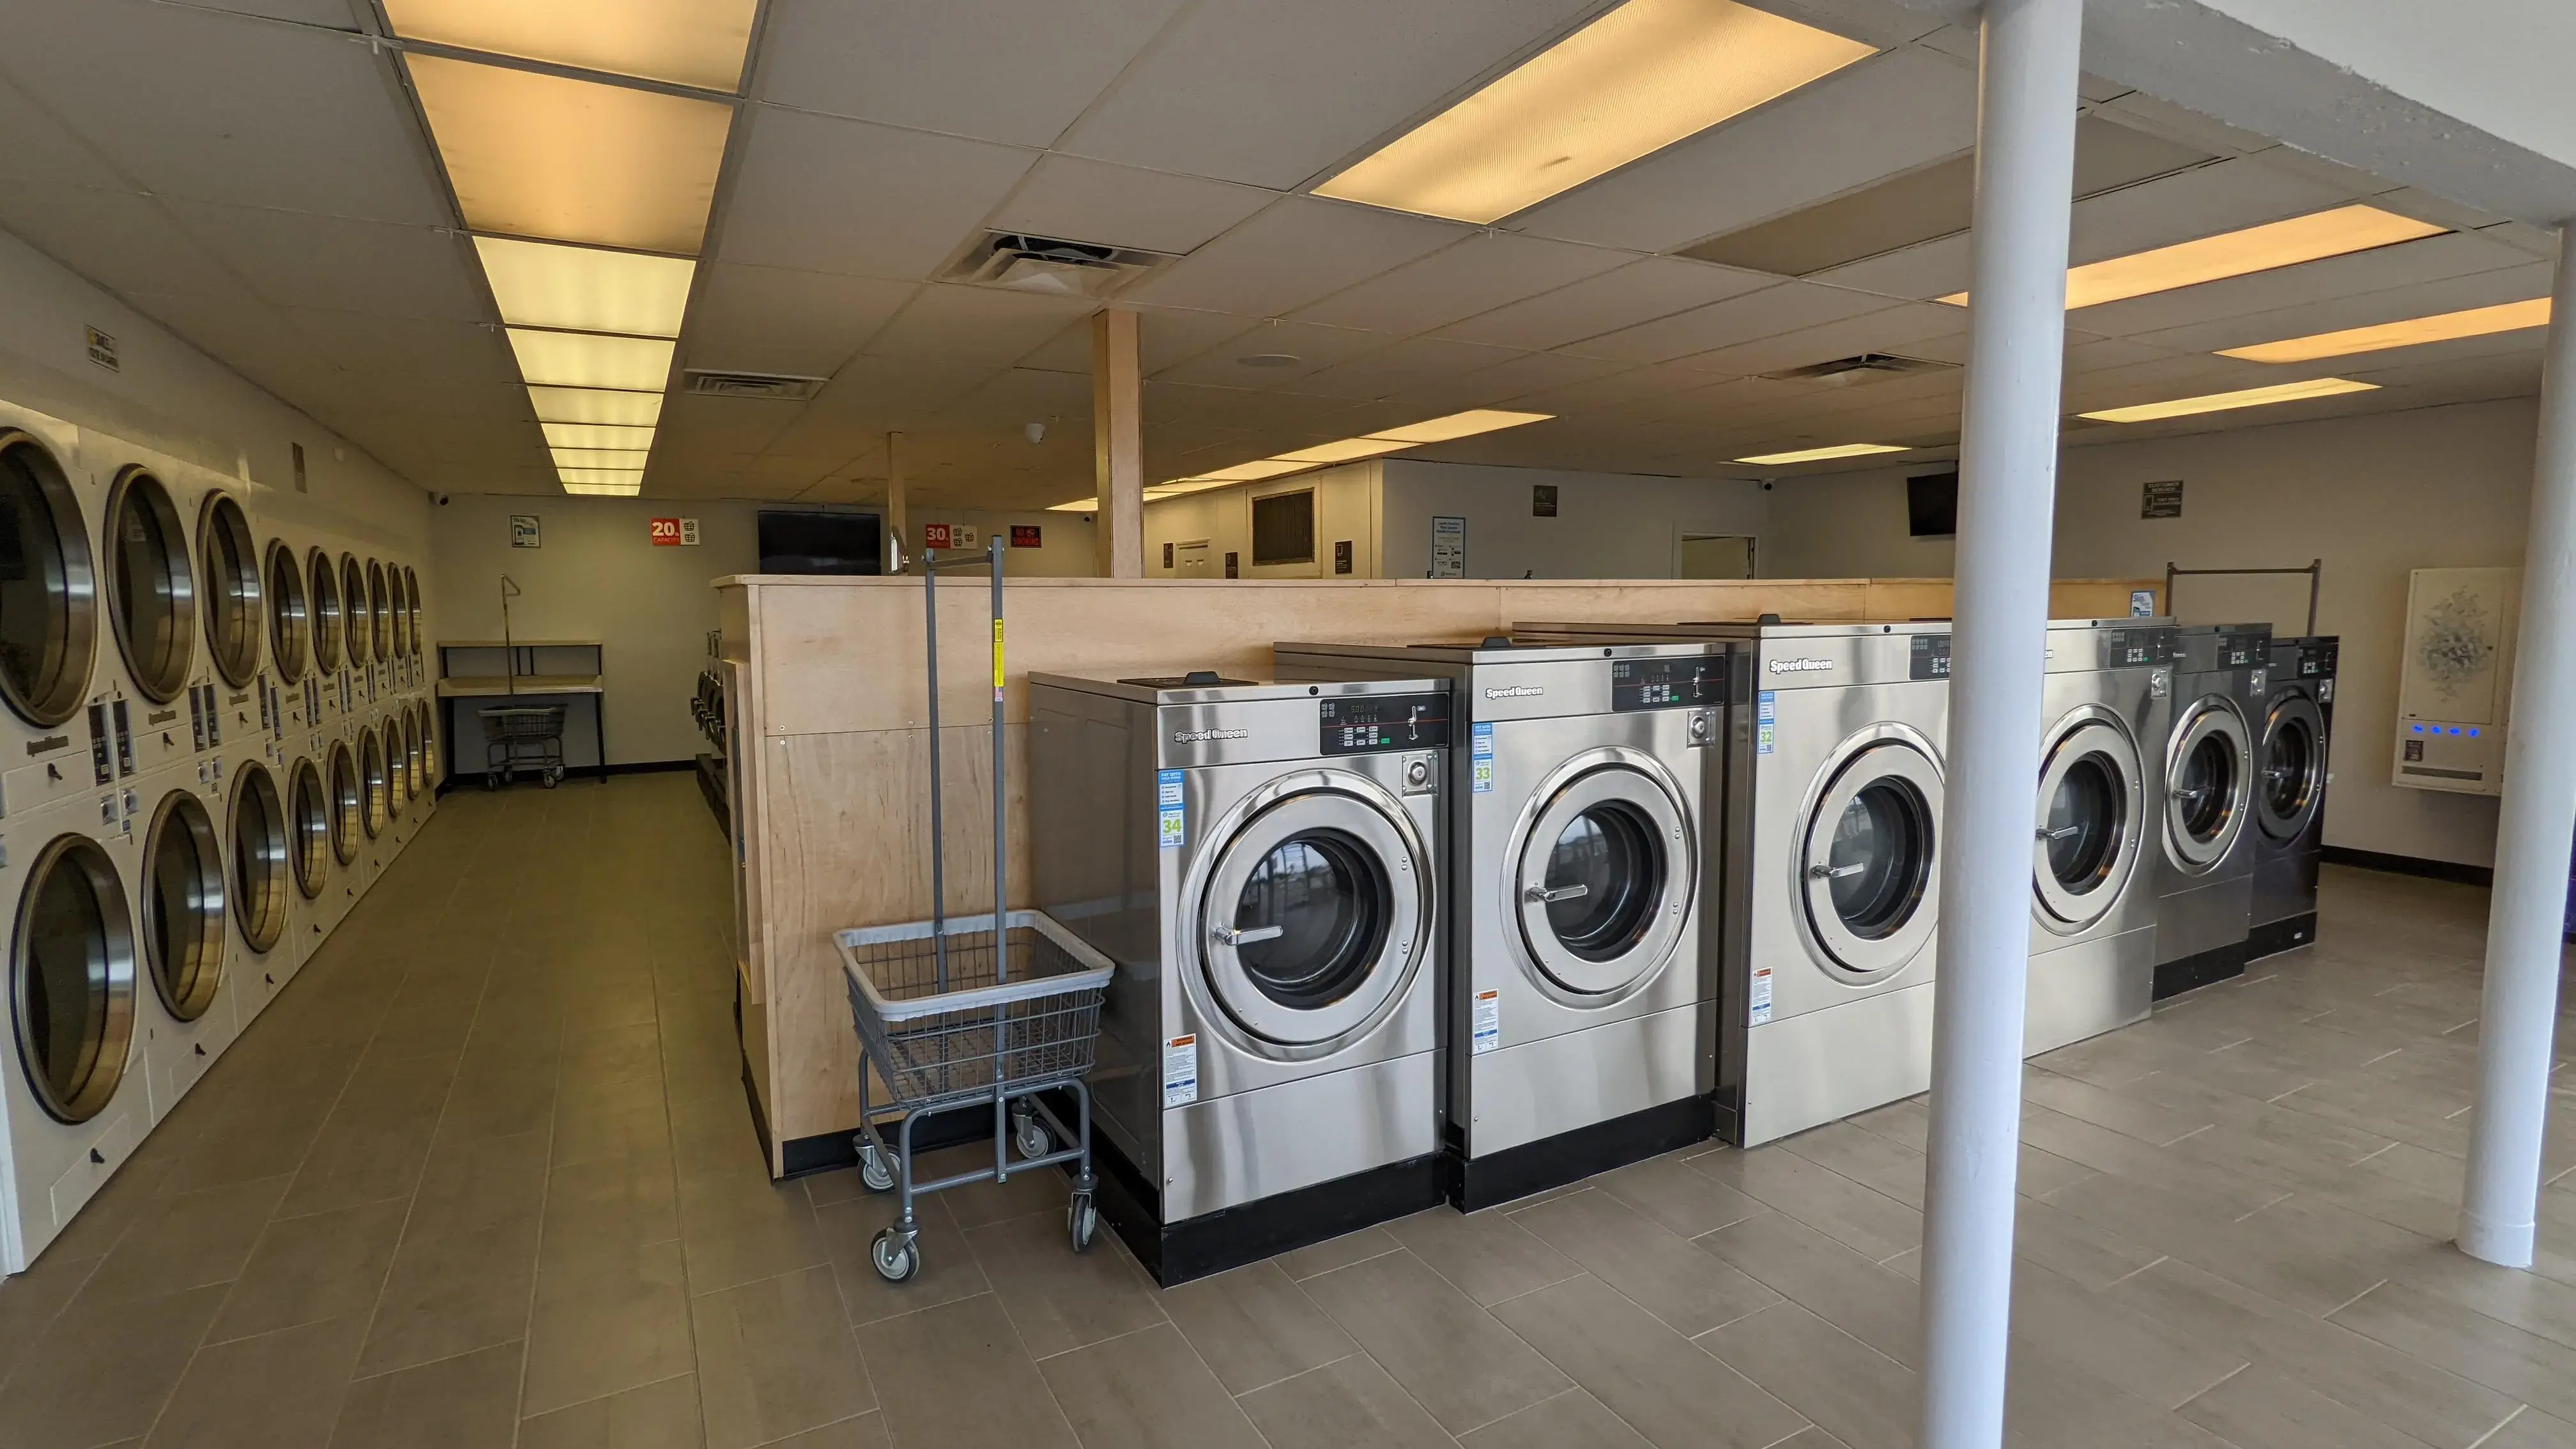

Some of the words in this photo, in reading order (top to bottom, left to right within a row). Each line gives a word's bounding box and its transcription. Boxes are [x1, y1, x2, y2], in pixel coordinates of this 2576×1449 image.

[652, 522, 675, 536] 20
[927, 528, 946, 540] 30
[1770, 658, 1802, 675] Speed
[1802, 658, 1832, 670] Queen
[1486, 687, 1515, 699] Speed
[1515, 686, 1543, 696] Queen
[1175, 729, 1212, 743] Speed
[1212, 728, 1248, 739] Queen
[1761, 732, 1772, 742] 32
[1476, 767, 1490, 780] 33
[1163, 819, 1181, 833] 34
